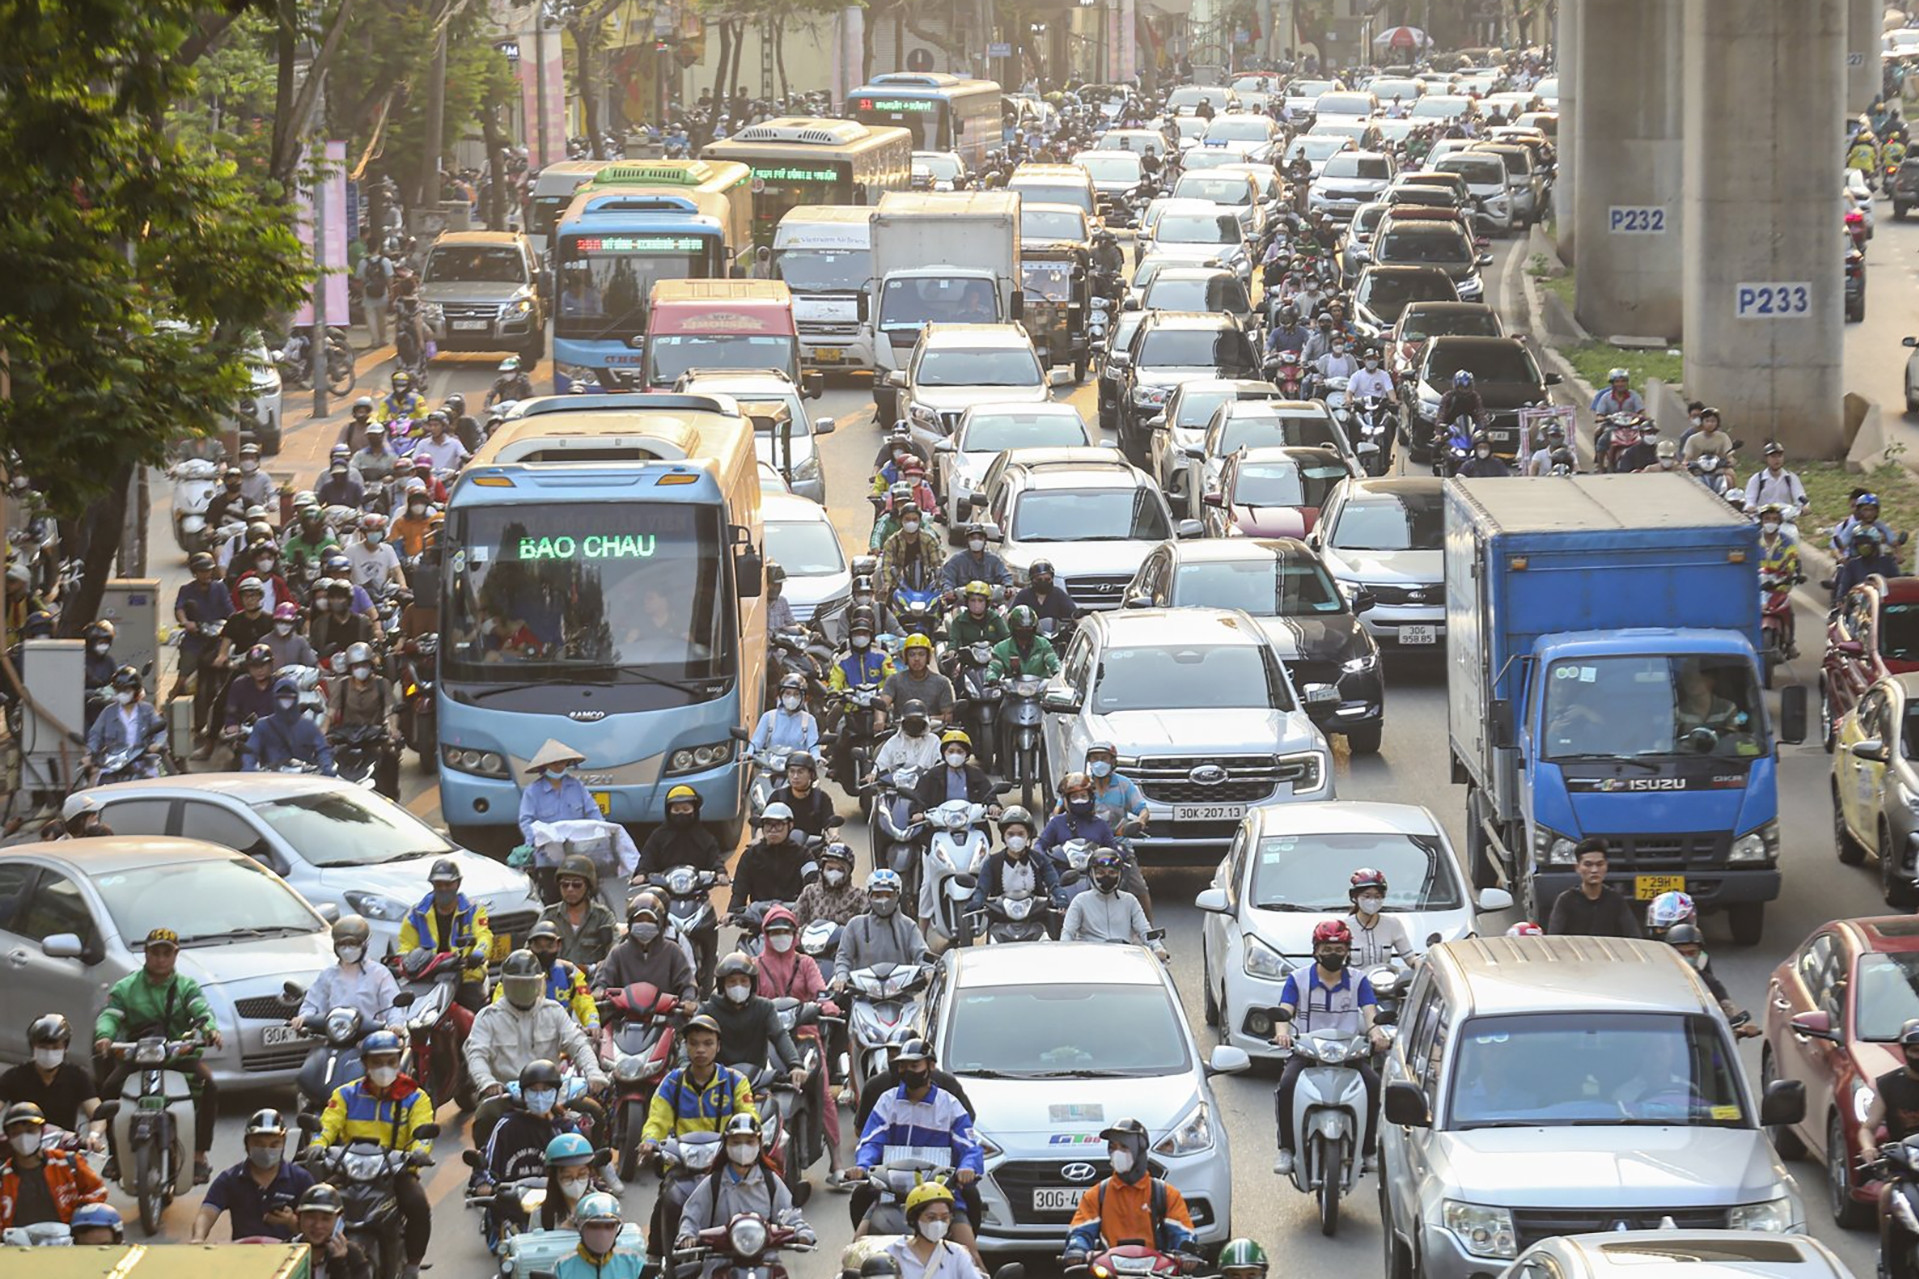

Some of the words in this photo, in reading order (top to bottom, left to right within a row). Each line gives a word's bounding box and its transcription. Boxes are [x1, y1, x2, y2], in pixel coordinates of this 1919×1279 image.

[1611, 209, 1664, 231] P232
[1740, 286, 1808, 314] P233
[519, 536, 576, 559] BAO
[583, 534, 656, 558] CHAU
[1409, 627, 1425, 635] 30G
[1630, 778, 1686, 790] ISUZU
[1179, 807, 1241, 819] 30K-207.13
[1650, 877, 1671, 888] 29H
[1036, 1191, 1086, 1208] 30G-4
